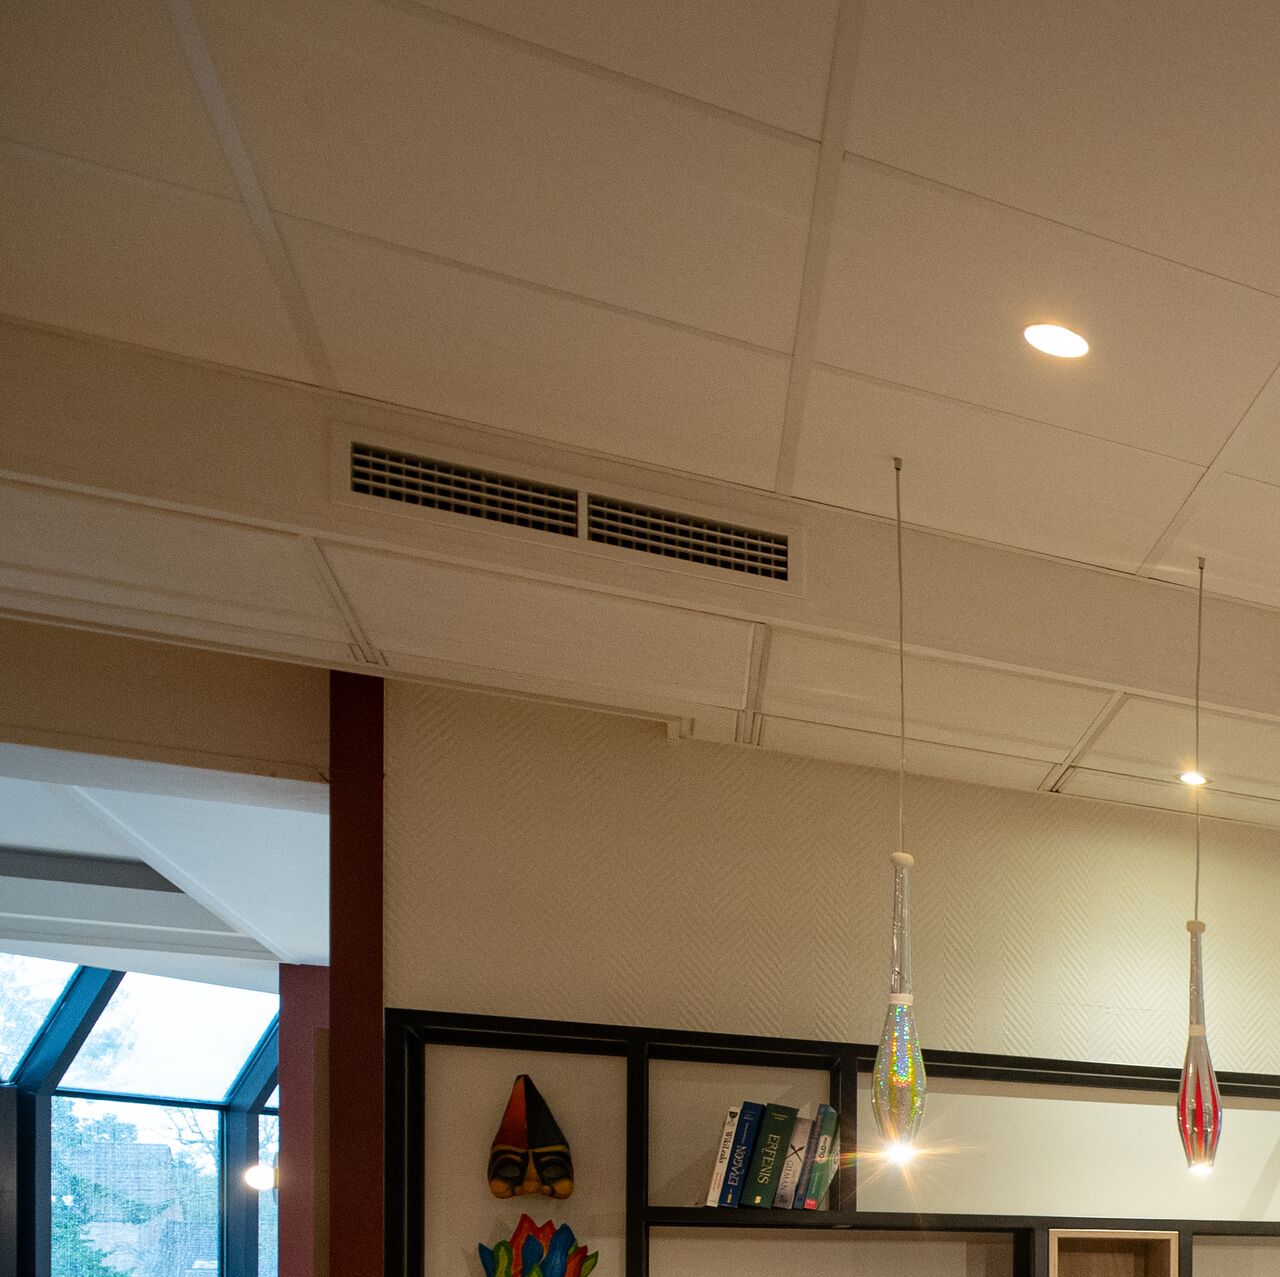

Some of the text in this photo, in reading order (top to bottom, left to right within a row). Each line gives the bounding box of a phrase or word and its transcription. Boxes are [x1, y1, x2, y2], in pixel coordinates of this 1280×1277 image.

[719, 1131, 733, 1163] WikiLeaks
[727, 1145, 748, 1186] ERAGON
[757, 1134, 780, 1184] ERFENIS
